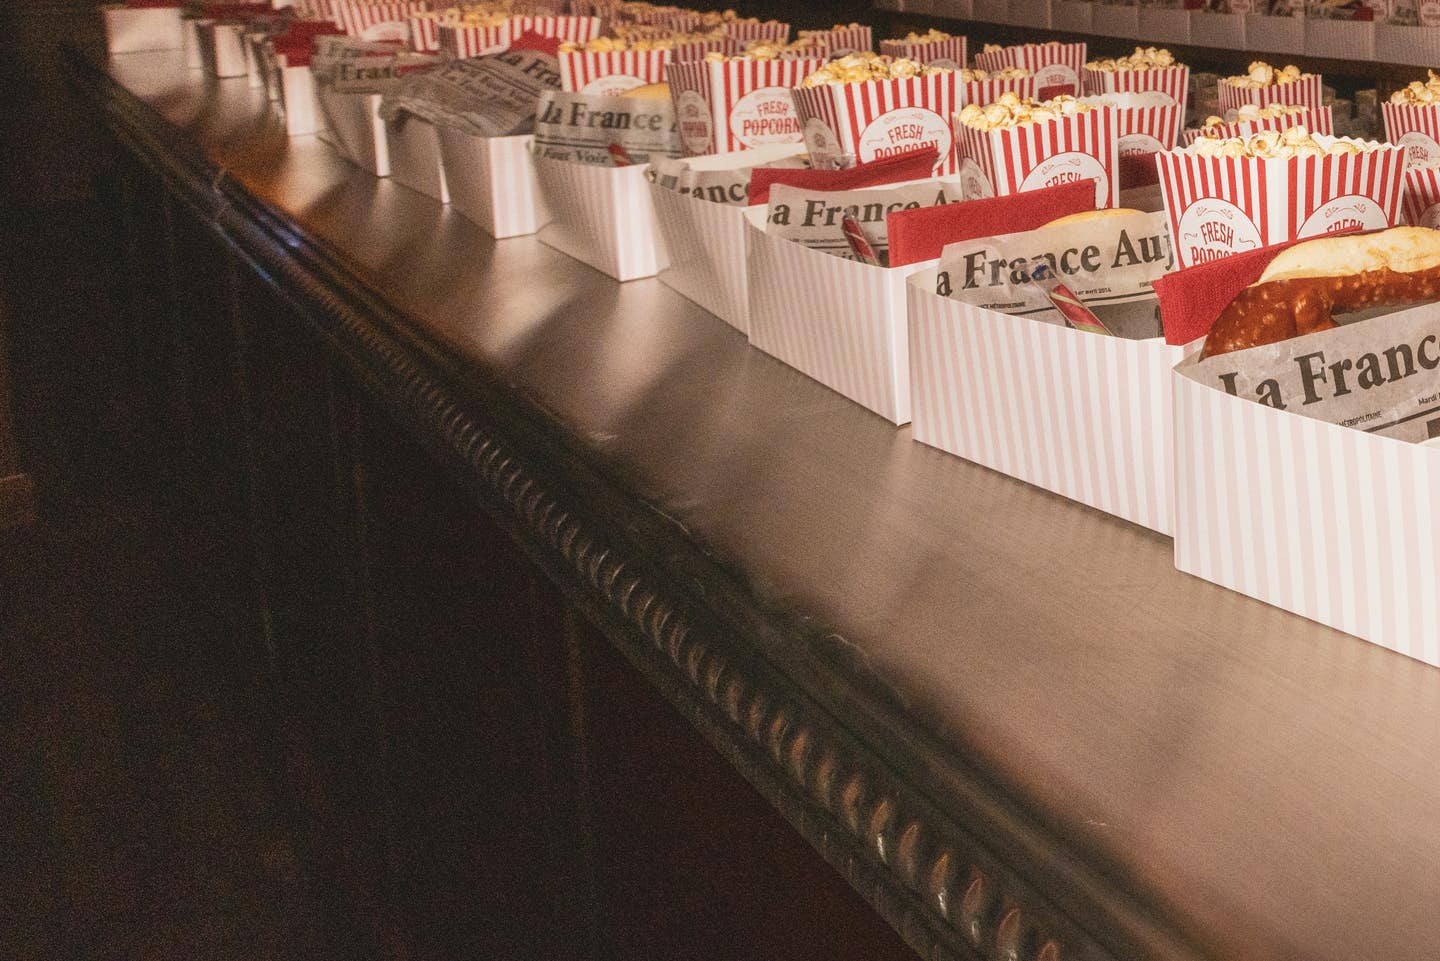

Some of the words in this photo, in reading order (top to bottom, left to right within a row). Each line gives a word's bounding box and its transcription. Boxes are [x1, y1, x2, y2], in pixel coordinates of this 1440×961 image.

[569, 102, 662, 132] France
[757, 101, 788, 117] FRESH
[743, 117, 801, 137] POPCORN
[887, 123, 924, 144] FRESH
[1409, 145, 1428, 161] FRESH
[1200, 221, 1234, 248] FRESH
[962, 243, 1101, 290] France
[1417, 391, 1438, 407] Mardi
